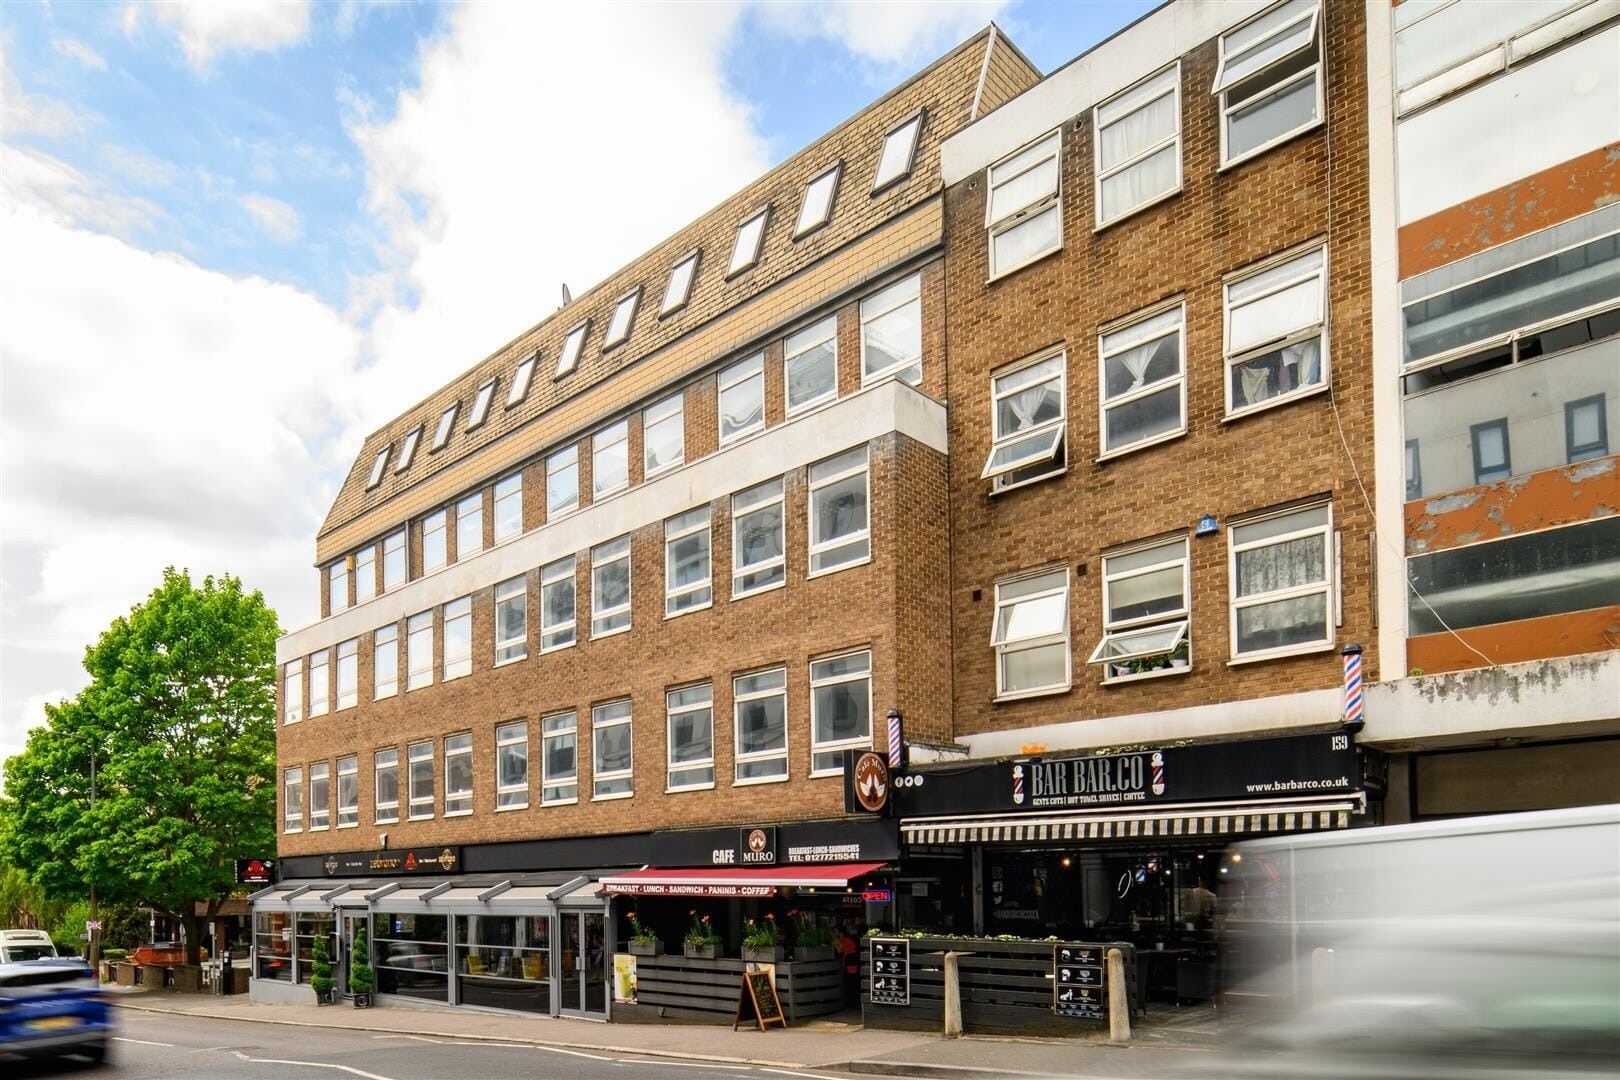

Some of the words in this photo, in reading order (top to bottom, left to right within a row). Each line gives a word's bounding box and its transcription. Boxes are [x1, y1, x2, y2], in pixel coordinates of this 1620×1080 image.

[1331, 735, 1348, 751] 159
[1031, 763, 1067, 796] BAR
[1073, 755, 1144, 793] BAR.CO
[1246, 776, 1349, 792] www.barbarco.co.uk
[712, 849, 735, 864] CAFE
[743, 851, 774, 862] MURO
[643, 885, 665, 893] LUNCH
[668, 885, 704, 895] SANDWICH
[708, 886, 737, 895] PANINIS
[863, 891, 888, 900] OPEN
